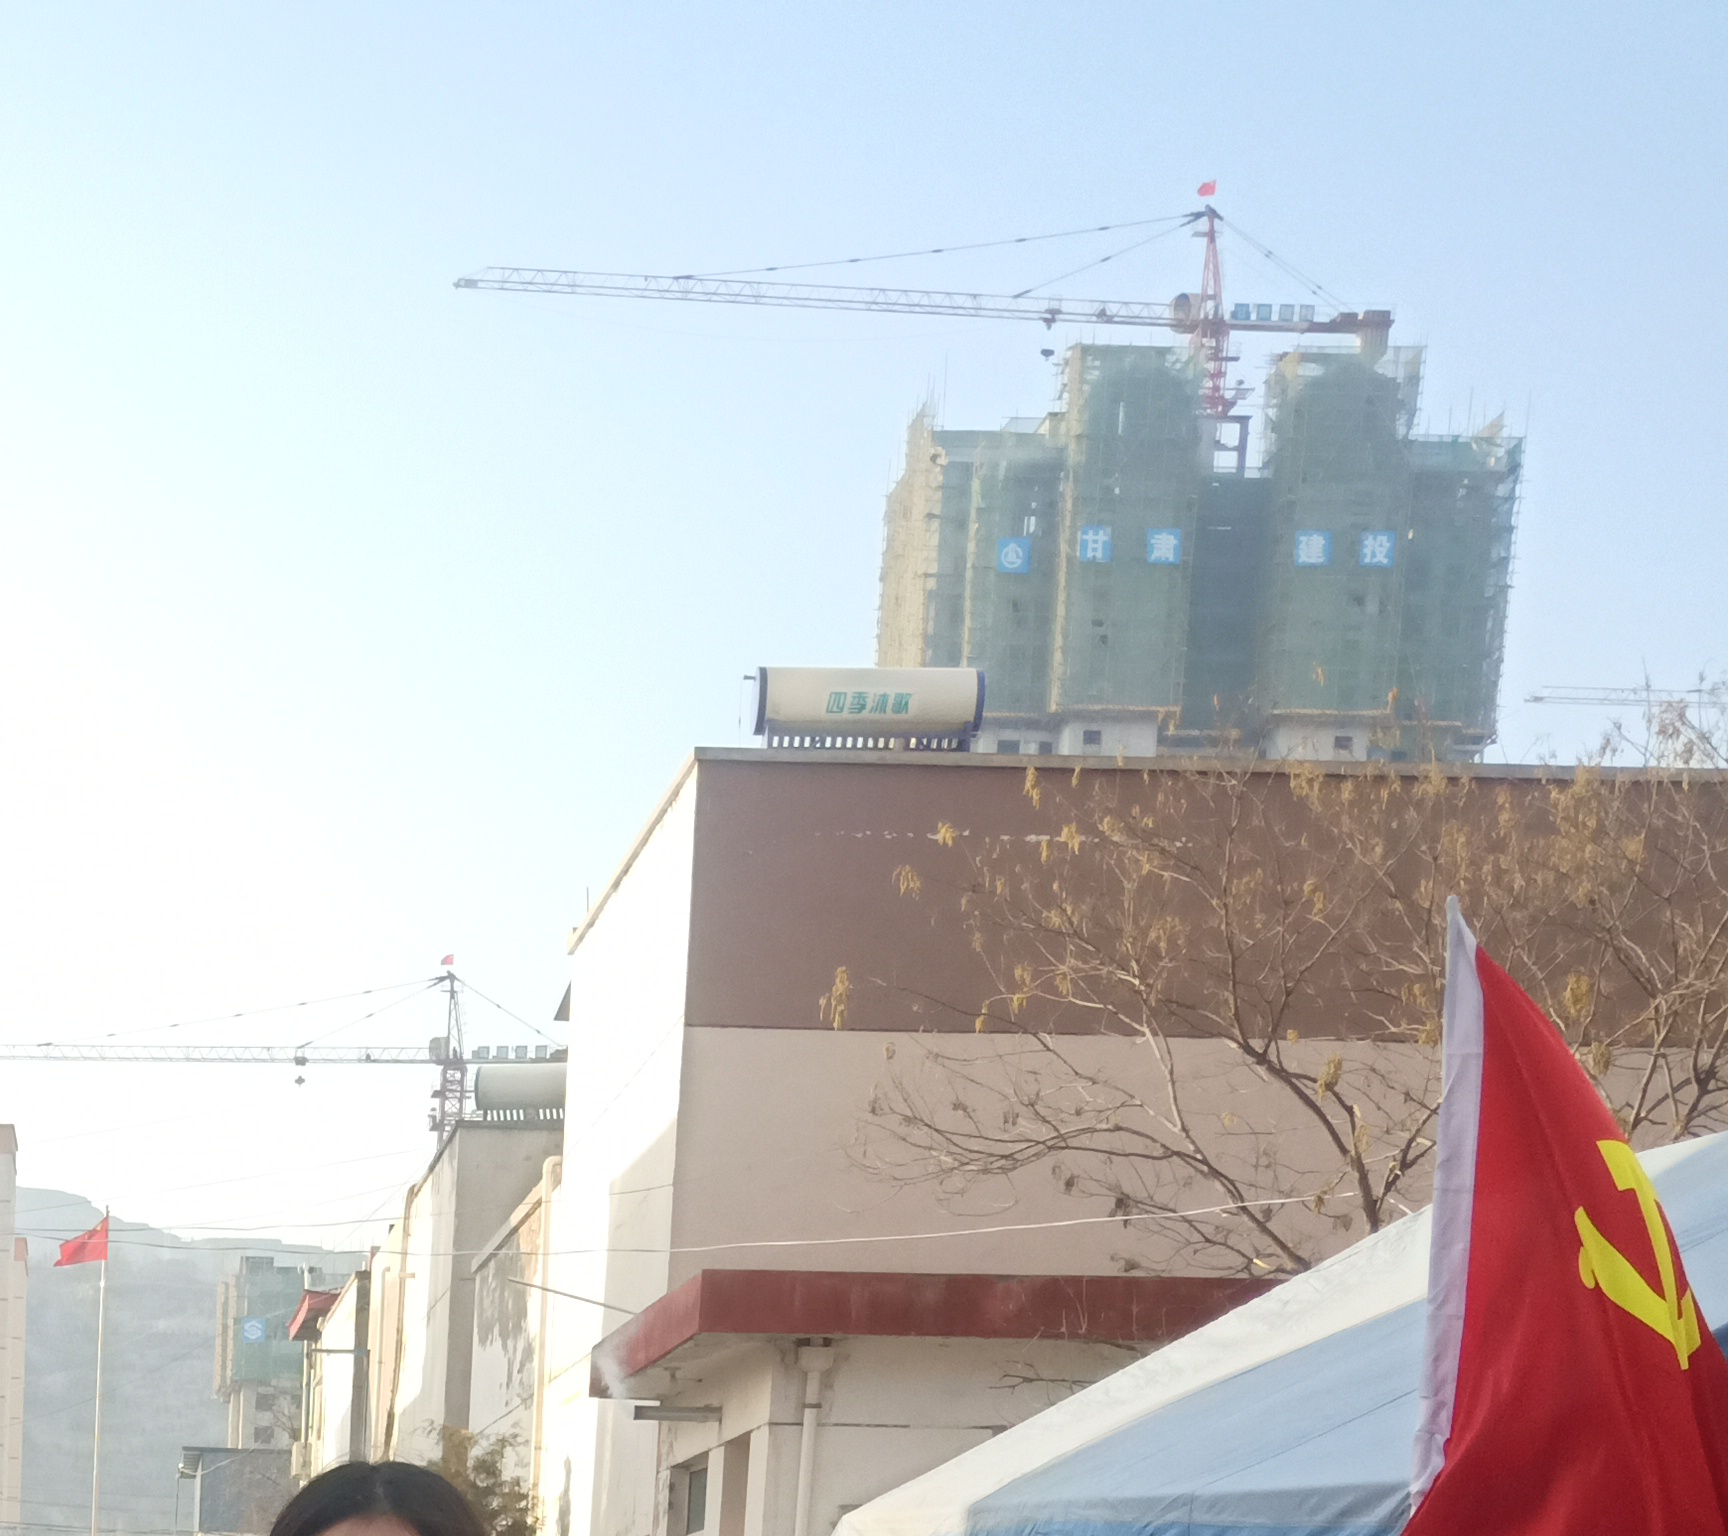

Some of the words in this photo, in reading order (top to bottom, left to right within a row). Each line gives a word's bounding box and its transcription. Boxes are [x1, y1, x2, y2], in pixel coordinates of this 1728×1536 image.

[1082, 530, 1391, 565] 甘肃建投
[825, 691, 913, 715] 四季沐歌
